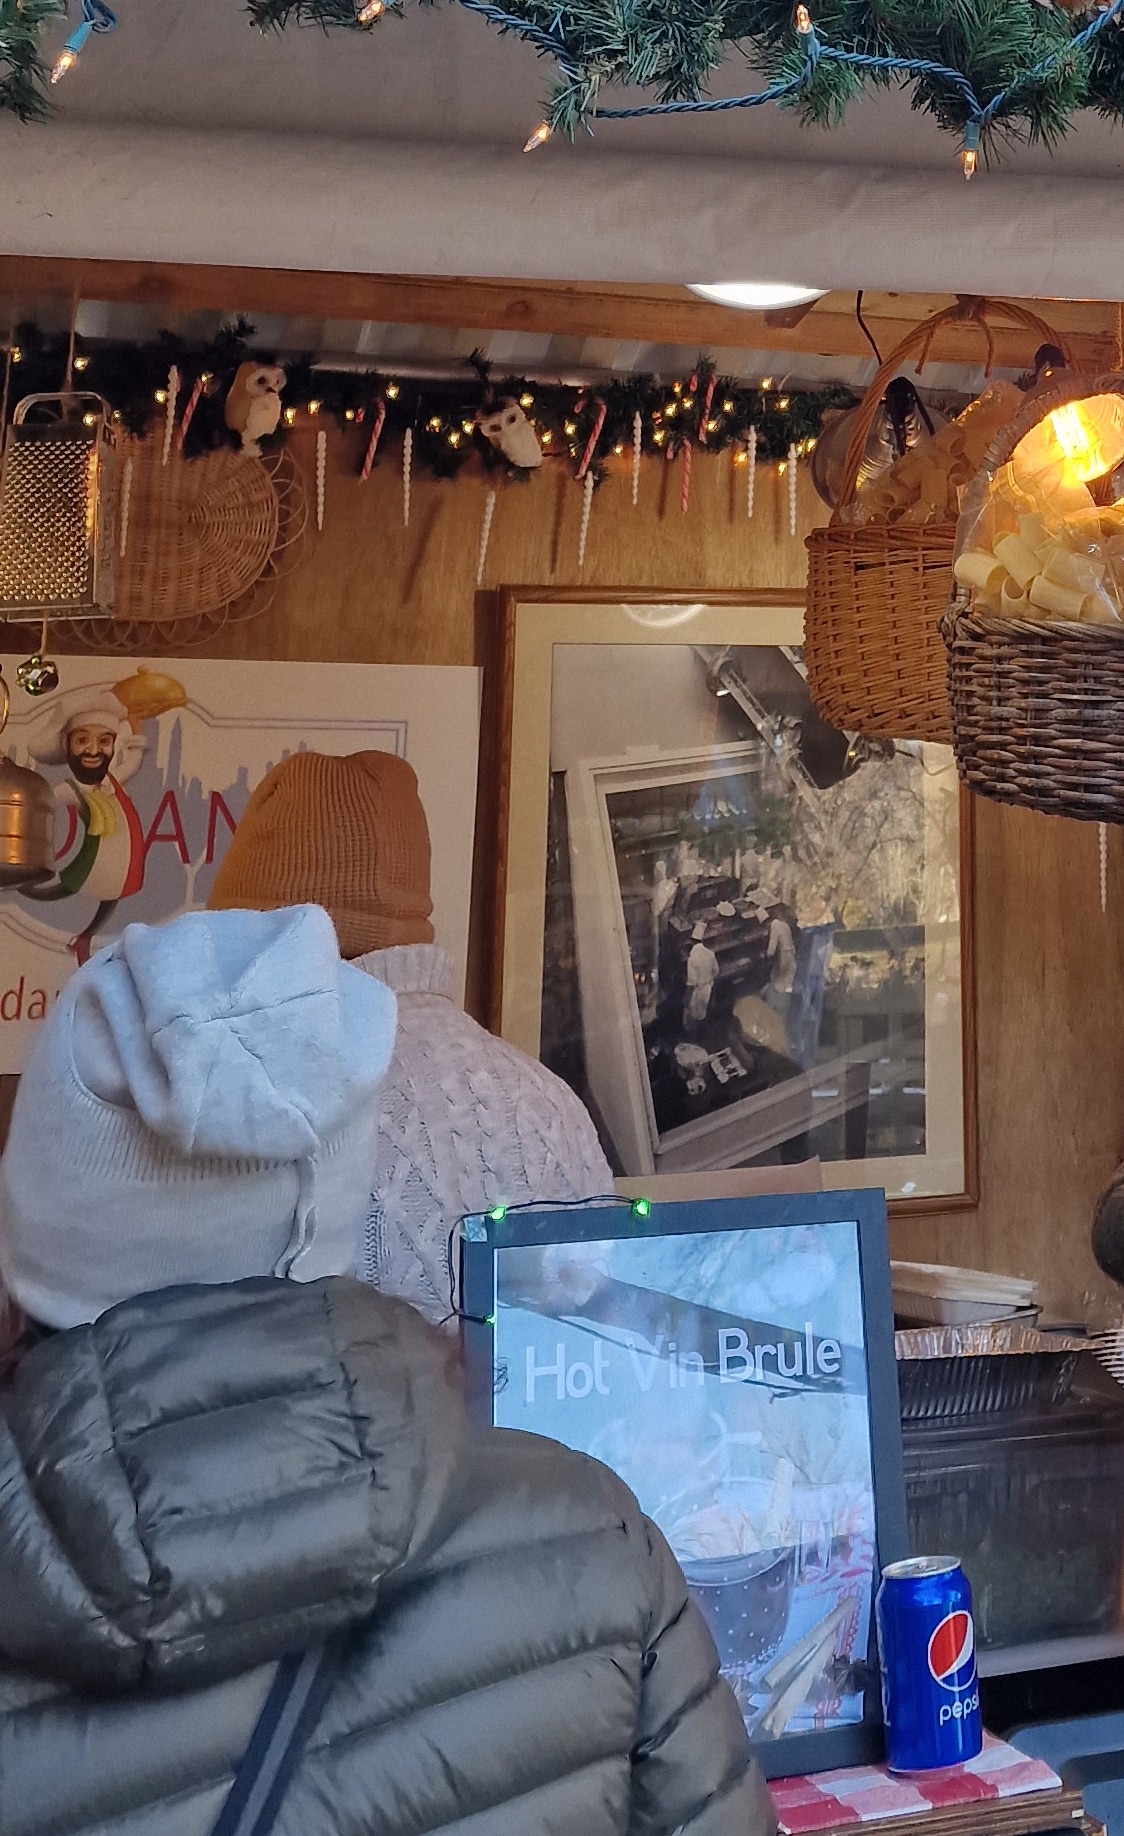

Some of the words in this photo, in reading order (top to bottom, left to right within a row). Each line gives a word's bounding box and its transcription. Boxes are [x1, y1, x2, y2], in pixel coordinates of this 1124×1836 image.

[526, 1338, 610, 1403] Hot
[625, 1333, 705, 1392] Vin
[718, 1321, 842, 1384] Brule
